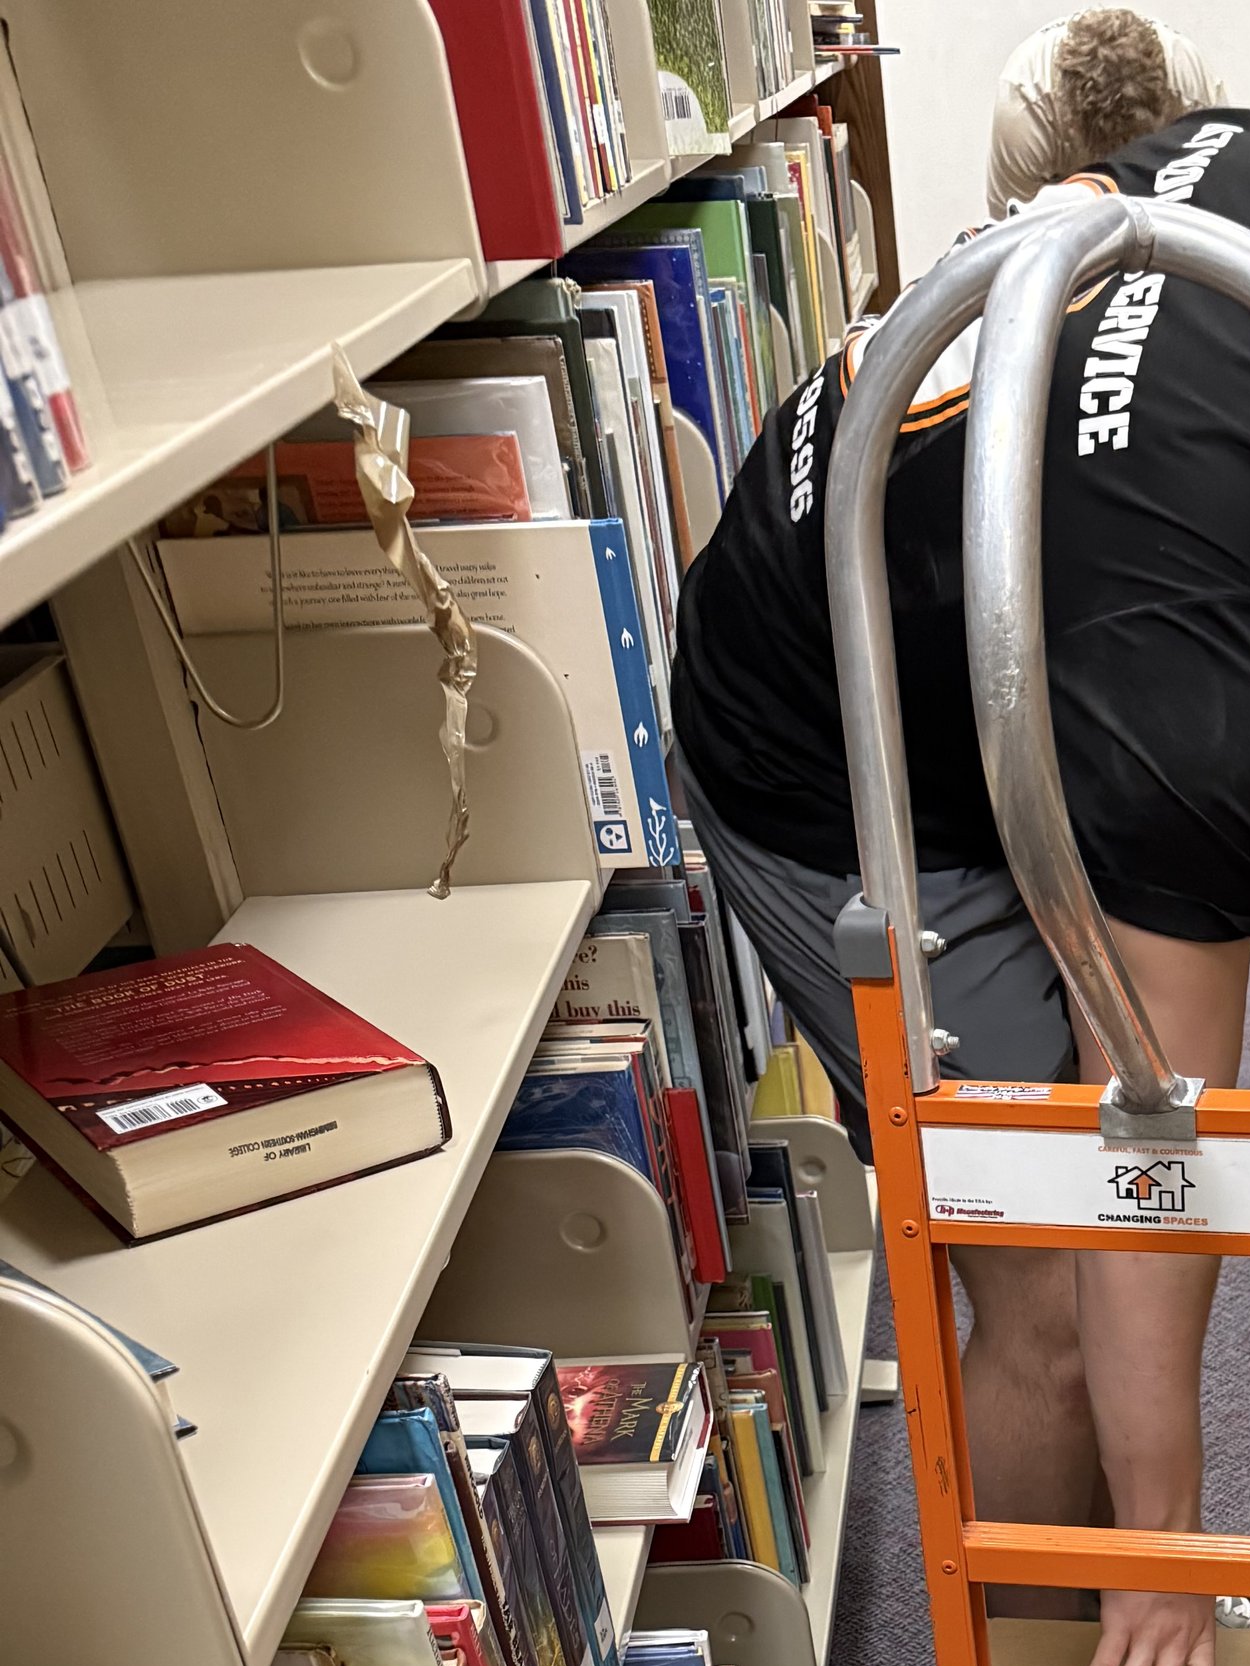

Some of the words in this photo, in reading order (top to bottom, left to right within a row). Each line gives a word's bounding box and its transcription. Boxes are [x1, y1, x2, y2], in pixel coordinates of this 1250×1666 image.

[1078, 271, 1165, 456] ERVICE
[91, 990, 134, 1004] BOOK
[608, 1000, 641, 1017] this
[1097, 1213, 1161, 1224] CHANGING
[1163, 1216, 1208, 1226] SPACES
[607, 1378, 620, 1392] OF
[630, 1381, 647, 1396] THE
[583, 1391, 623, 1446] ATHENA
[610, 1397, 653, 1442] MARK
